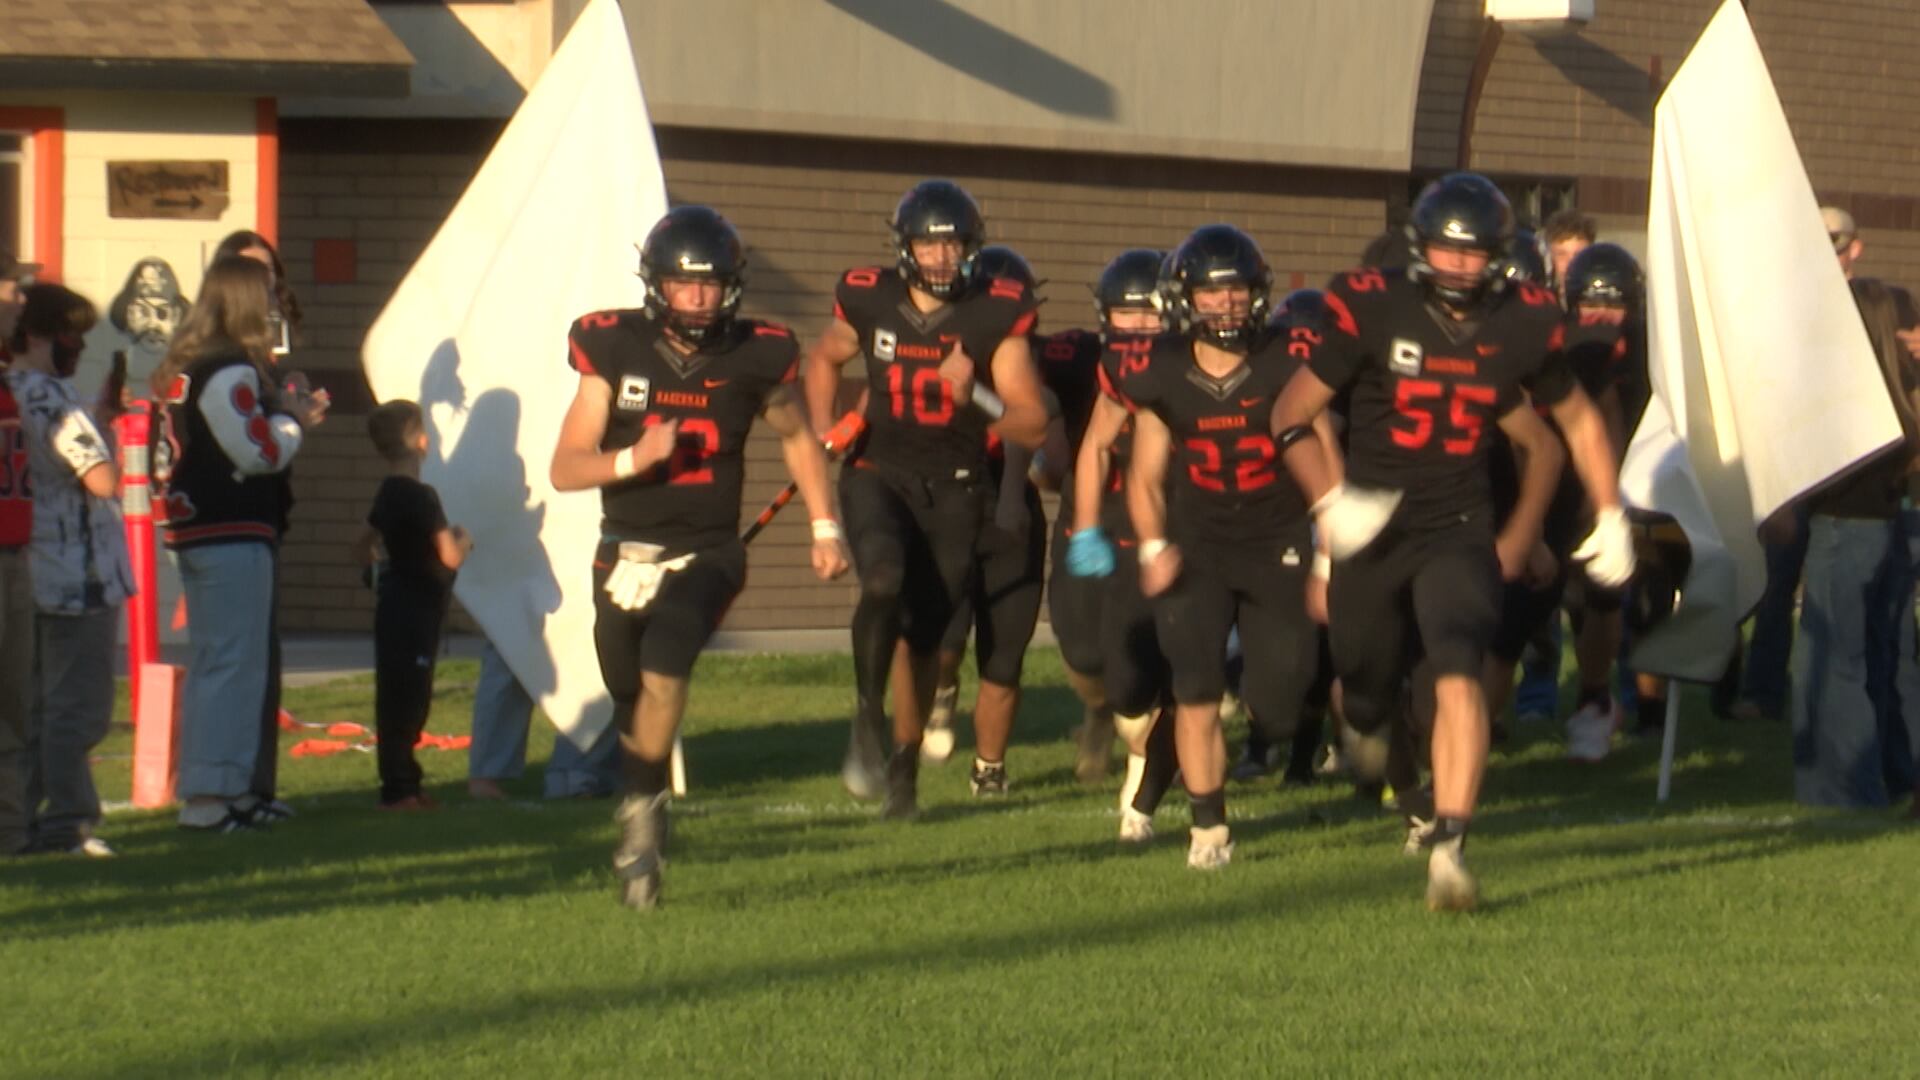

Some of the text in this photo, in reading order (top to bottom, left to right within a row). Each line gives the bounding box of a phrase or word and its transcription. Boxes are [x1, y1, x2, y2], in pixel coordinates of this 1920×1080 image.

[885, 362, 955, 426] 10
[1389, 377, 1498, 456] 55
[643, 413, 721, 486] 2
[1185, 435, 1277, 493] 22
